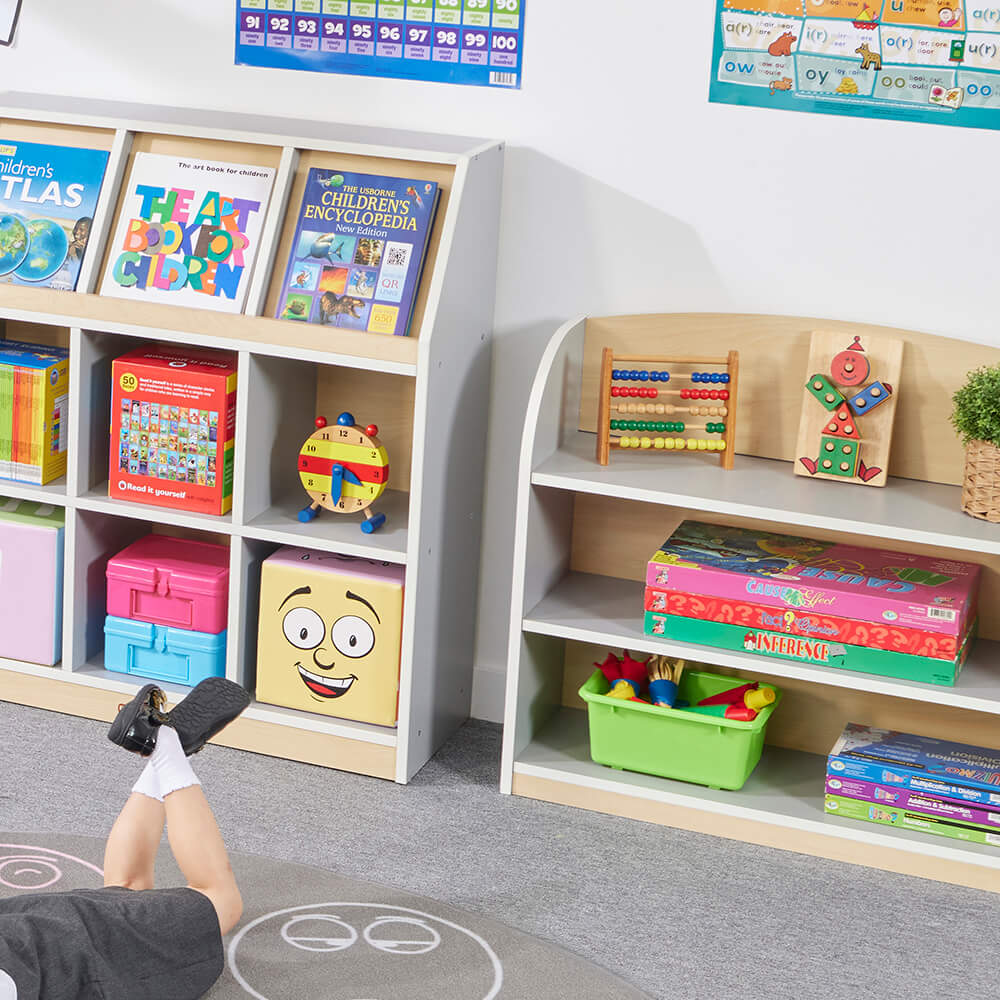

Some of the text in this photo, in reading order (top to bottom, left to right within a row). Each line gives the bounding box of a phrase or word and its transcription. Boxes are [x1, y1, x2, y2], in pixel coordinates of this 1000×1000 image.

[496, 0, 518, 11] 90
[245, 15, 517, 50] 91 92 93 94 95 96 97 98 99 100
[725, 61, 754, 73] ow
[805, 69, 829, 85] oy
[206, 165, 224, 174] book
[238, 169, 269, 178] children
[343, 185, 396, 198] THE USBORNE
[135, 184, 261, 233] THE ART
[321, 191, 411, 215] CHILDREN'S
[304, 204, 418, 231] ENCYCLOPEDIA
[335, 223, 388, 238] New Edition
[122, 218, 250, 267] BOOK FOR
[112, 251, 245, 300] CHILDREN
[381, 278, 399, 289] QR
[122, 375, 135, 386] 50
[339, 430, 348, 438] 12
[127, 483, 147, 493] Read
[147, 486, 154, 494] it
[155, 489, 186, 499] yourself
[799, 566, 917, 593] CAUSE
[800, 587, 837, 608] Effect
[756, 631, 829, 662] INFERENCE
